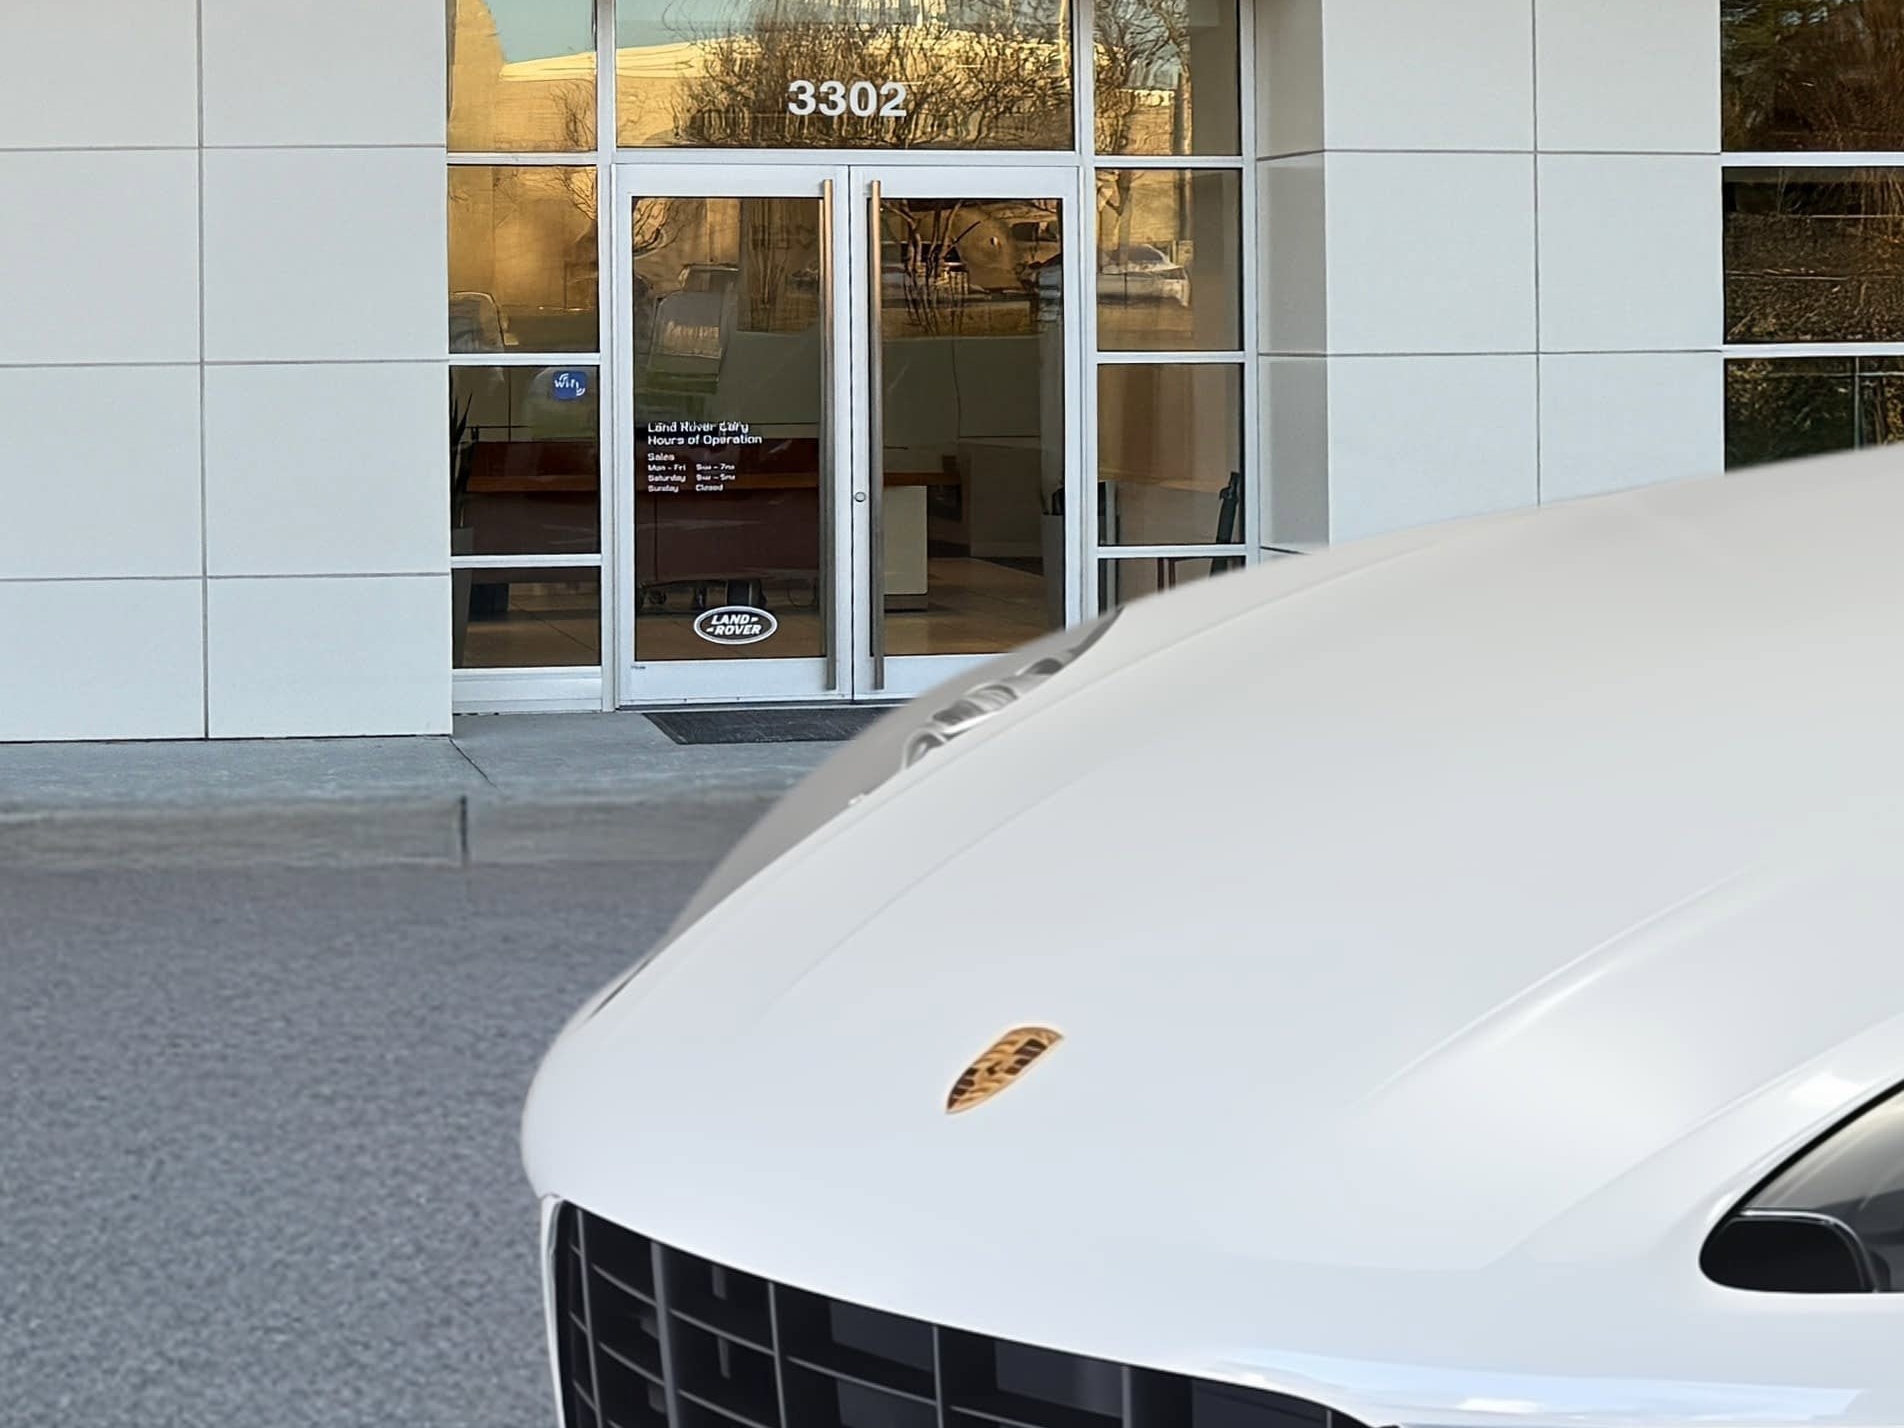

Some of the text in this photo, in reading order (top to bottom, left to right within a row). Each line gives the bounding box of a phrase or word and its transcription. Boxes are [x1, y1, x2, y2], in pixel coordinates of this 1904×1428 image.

[787, 78, 908, 118] 3302
[647, 434, 763, 447] Hours of Operation
[711, 613, 751, 625] LAND
[714, 624, 762, 635] ROVER
